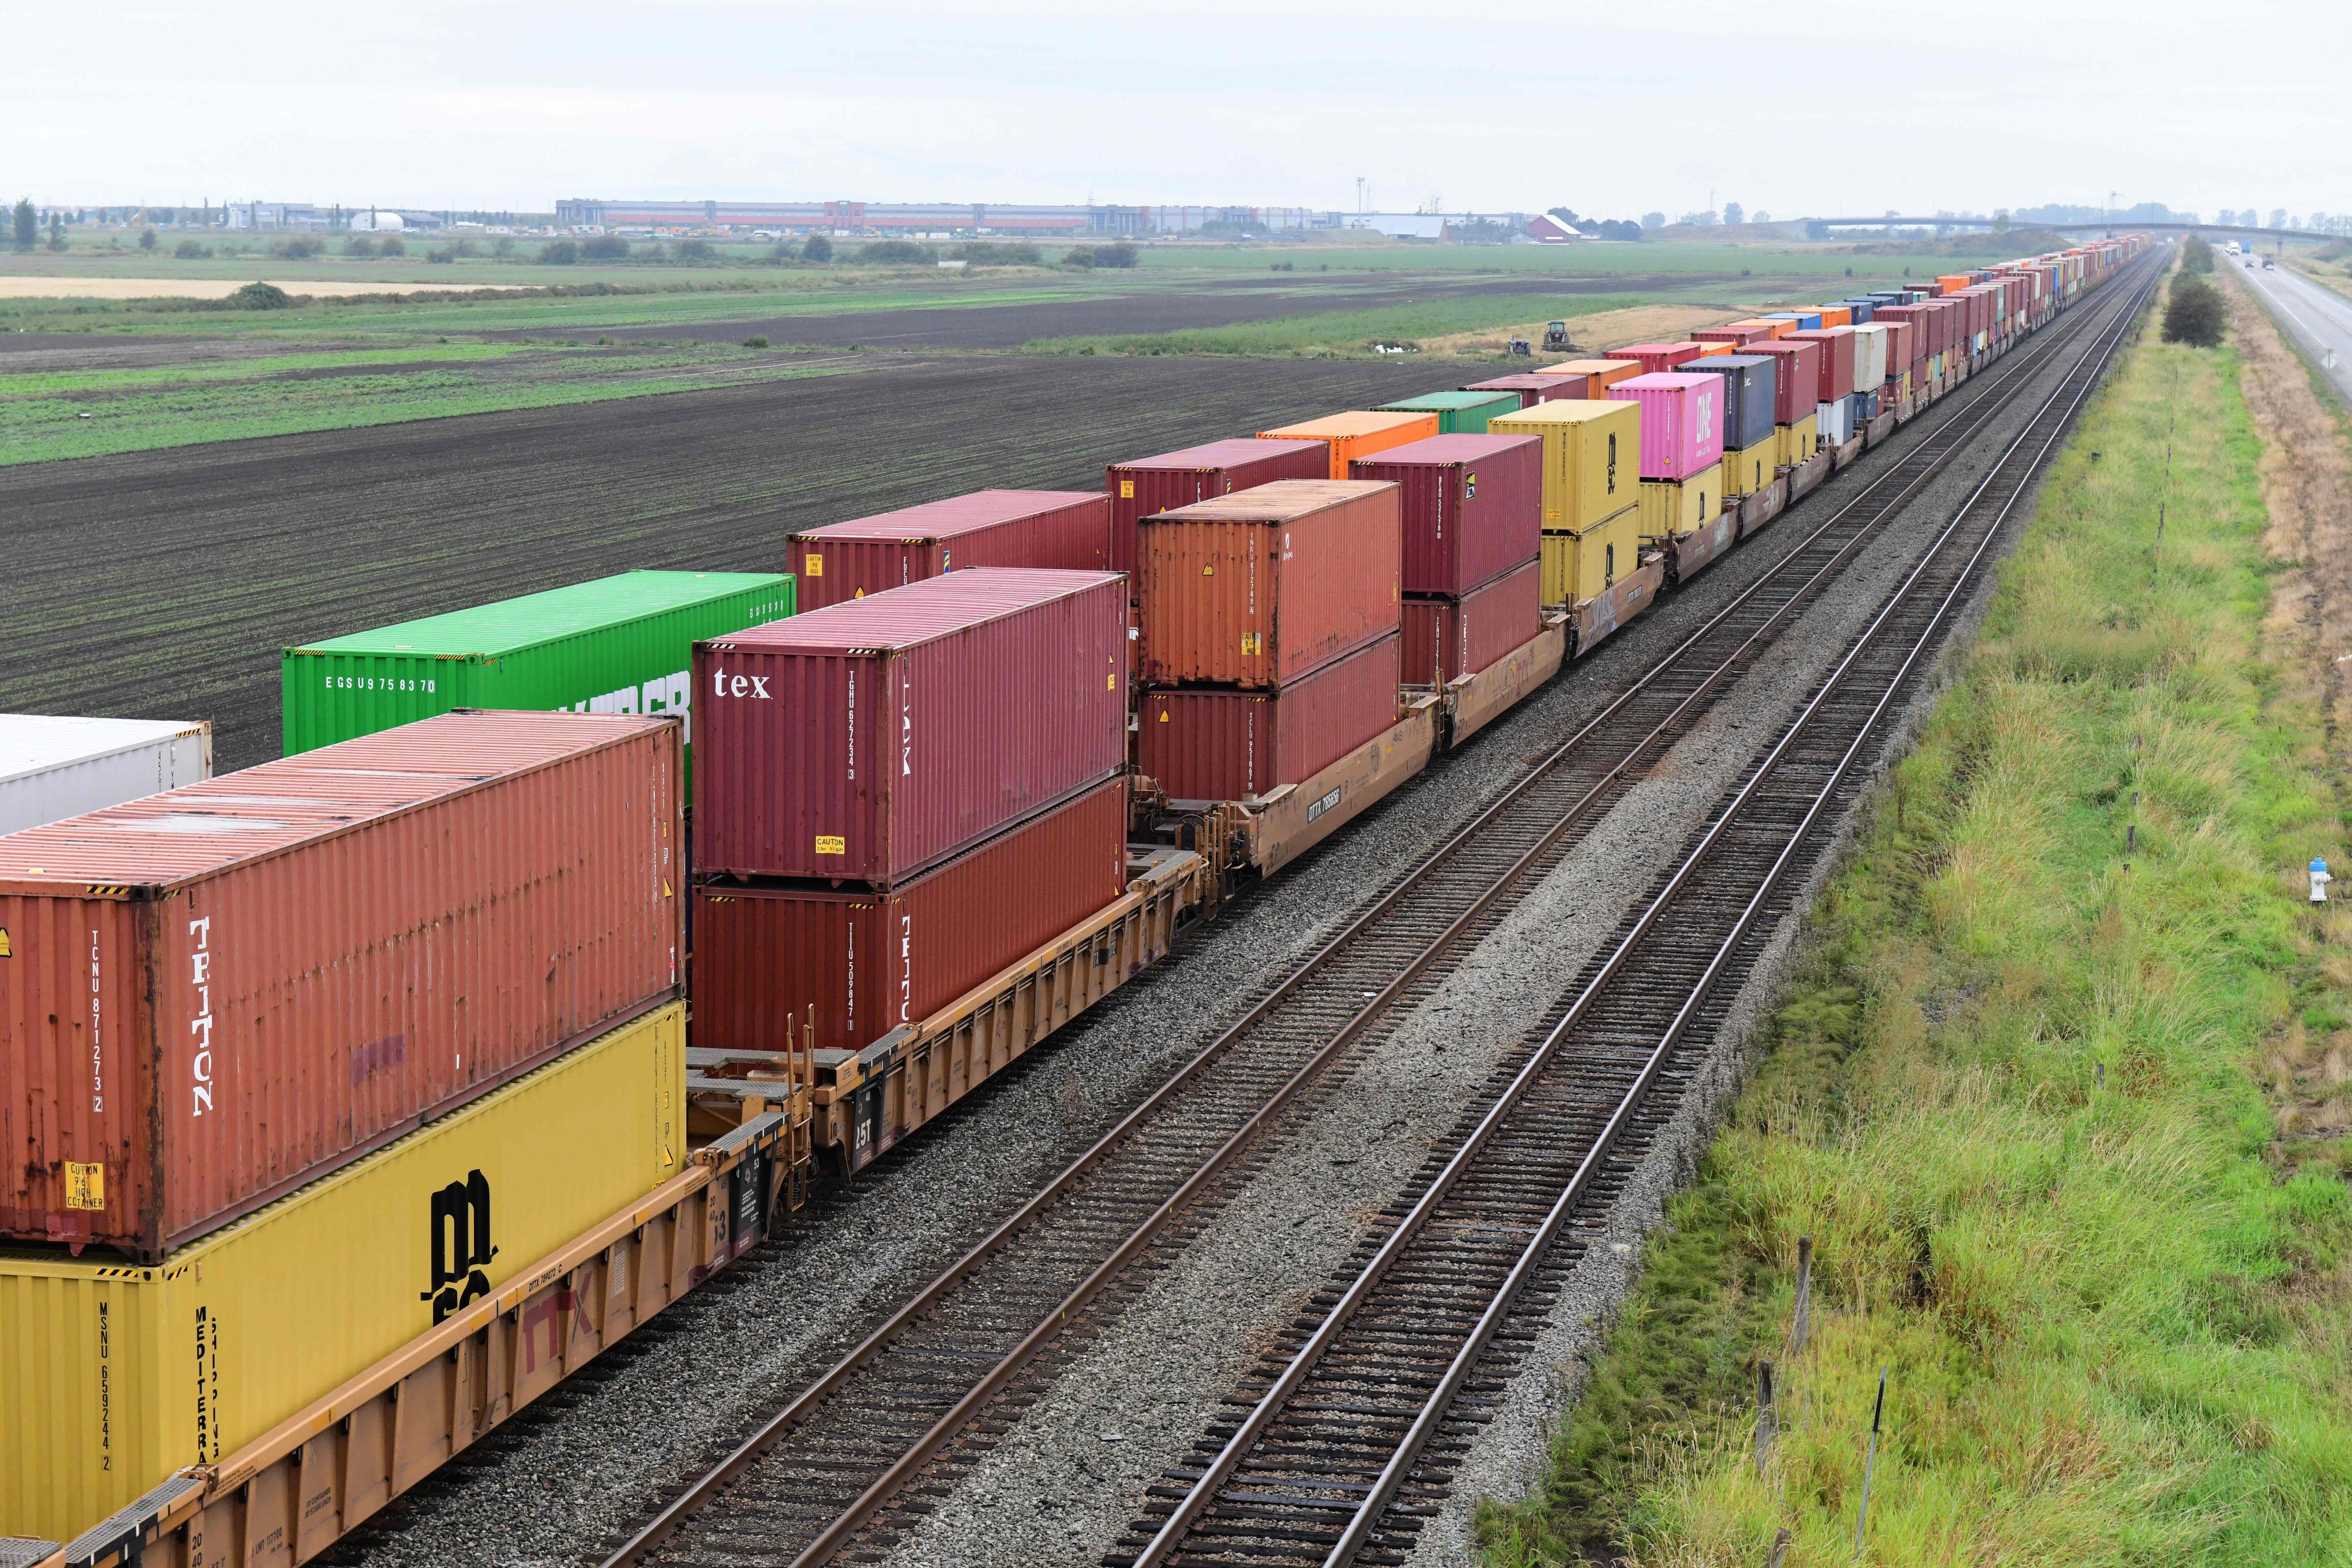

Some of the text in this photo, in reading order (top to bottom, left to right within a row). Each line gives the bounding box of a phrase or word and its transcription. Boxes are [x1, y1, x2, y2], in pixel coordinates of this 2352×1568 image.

[1697, 392, 1712, 443] ONE
[848, 768, 855, 779] 3
[1248, 782, 1253, 790] 9
[1309, 788, 1339, 822] DTTX 765656
[190, 916, 213, 1117] TRITON
[848, 1019, 853, 1030] 1
[93, 998, 101, 1091] 871273
[94, 1096, 102, 1112] 2
[754, 1158, 759, 1169] 53
[710, 1195, 715, 1207] 20
[529, 1264, 562, 1292] DTTX 789072 C
[99, 1302, 107, 1358] MSNU
[102, 1456, 110, 1469] 2
[192, 1532, 202, 1551] 20
[192, 1552, 202, 1568] 40
